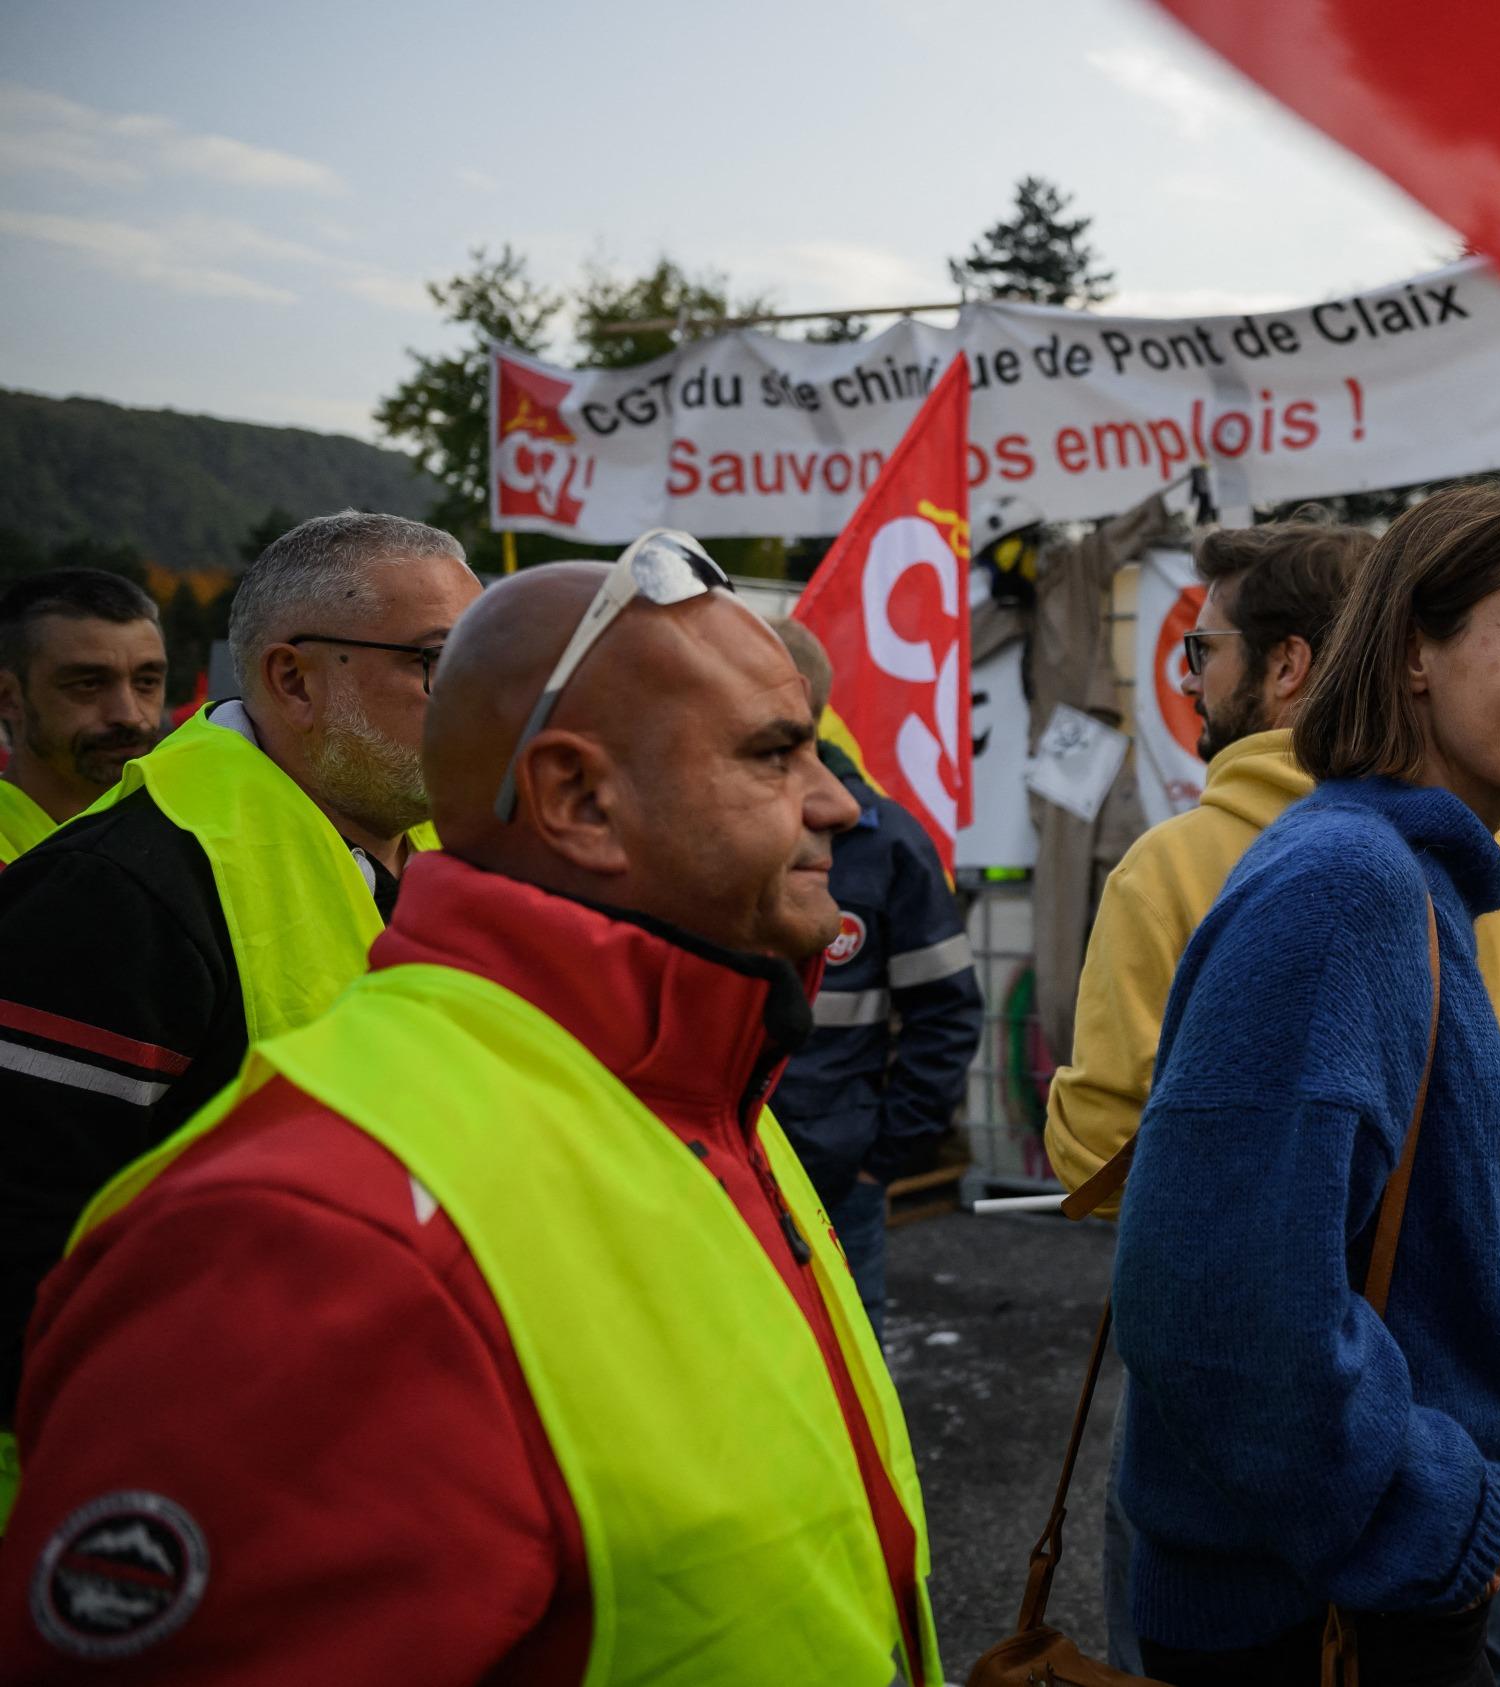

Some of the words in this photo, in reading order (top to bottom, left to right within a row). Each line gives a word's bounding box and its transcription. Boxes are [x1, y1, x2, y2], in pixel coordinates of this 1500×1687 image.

[581, 371, 673, 437] CGT
[681, 366, 741, 409] du
[1033, 333, 1092, 379] de
[1102, 321, 1226, 376] Pont
[1233, 314, 1301, 363] de
[1311, 282, 1472, 345] Claix
[665, 437, 886, 498] Sauvon
[966, 433, 1037, 490] os
[1056, 388, 1321, 479] emplois
[1344, 377, 1367, 441] !
